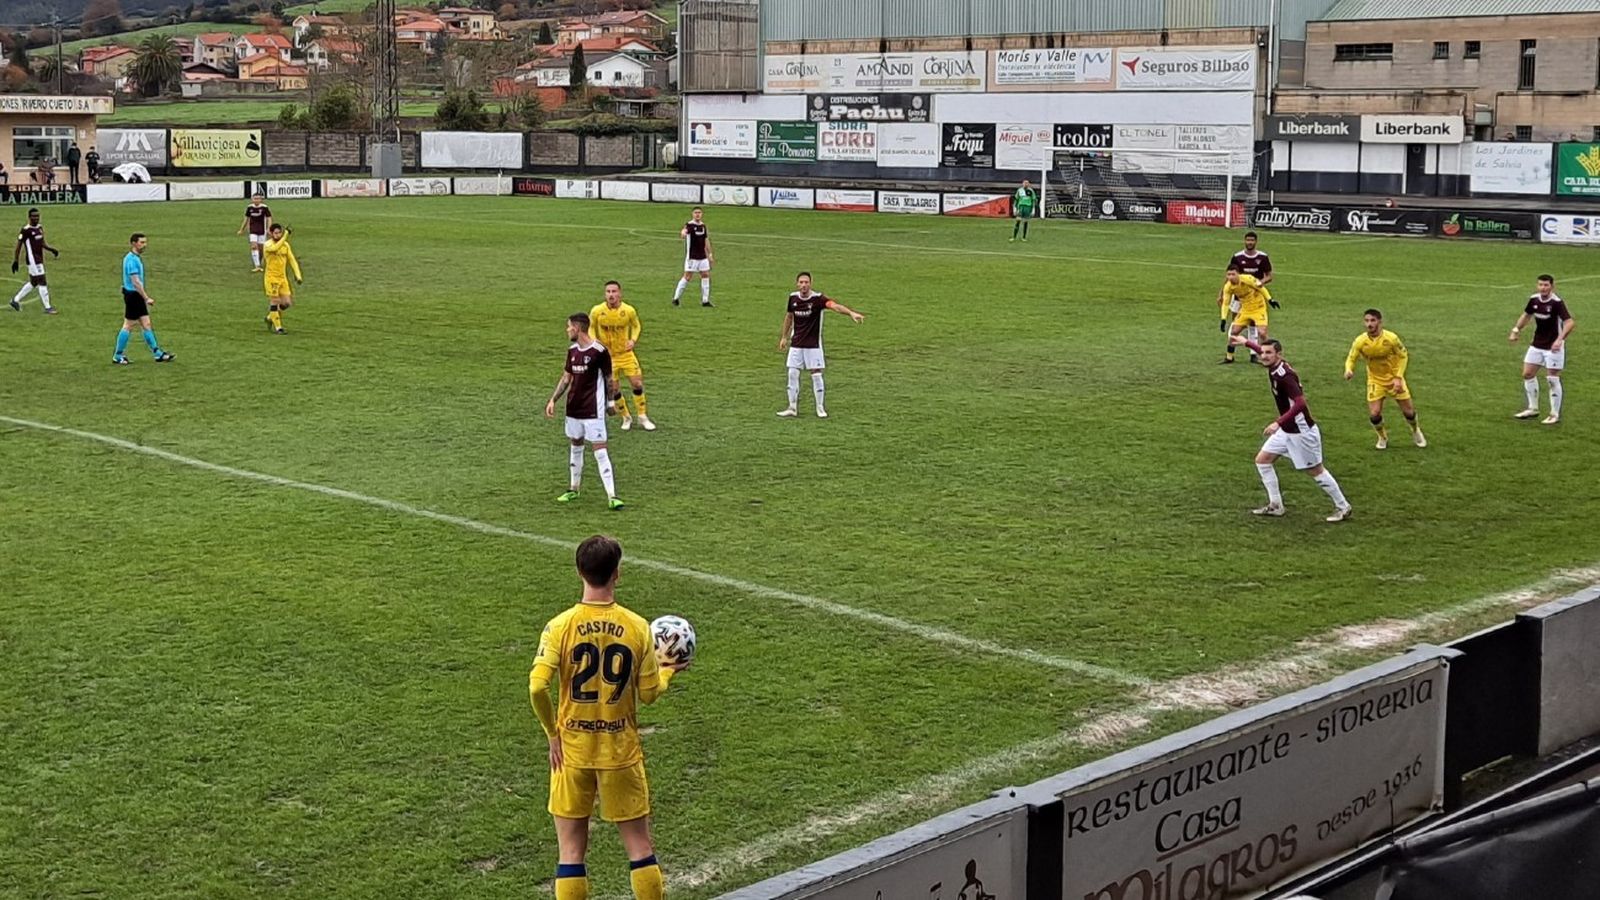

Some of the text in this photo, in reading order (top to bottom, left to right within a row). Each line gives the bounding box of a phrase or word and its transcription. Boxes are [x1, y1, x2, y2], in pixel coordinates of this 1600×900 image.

[1035, 52, 1041, 64] y
[1047, 50, 1076, 62] Valle
[857, 57, 913, 76] AMANDI
[924, 56, 975, 78] CORTINA
[1141, 59, 1249, 75] Seguros Bilbao
[829, 105, 905, 120] Pachu
[829, 121, 868, 130] SIDRA
[1279, 121, 1349, 135] Liberbank
[1375, 122, 1450, 135] Liberbank
[822, 131, 875, 147] CORO
[999, 132, 1033, 145] Miguel
[1056, 126, 1110, 147] icolor
[952, 134, 984, 157] Foyu
[1476, 145, 1544, 155] Los Jardines
[1475, 159, 1485, 168] de
[20, 191, 82, 204] BALLERA
[278, 186, 310, 195] moreno
[883, 196, 900, 207] CASA
[904, 198, 938, 208] MILAGROS
[1185, 204, 1225, 219] Mahou
[577, 620, 625, 638] CASTRO
[570, 642, 633, 705] 29
[1383, 753, 1423, 797] 1936
[1155, 796, 1242, 853] Casa
